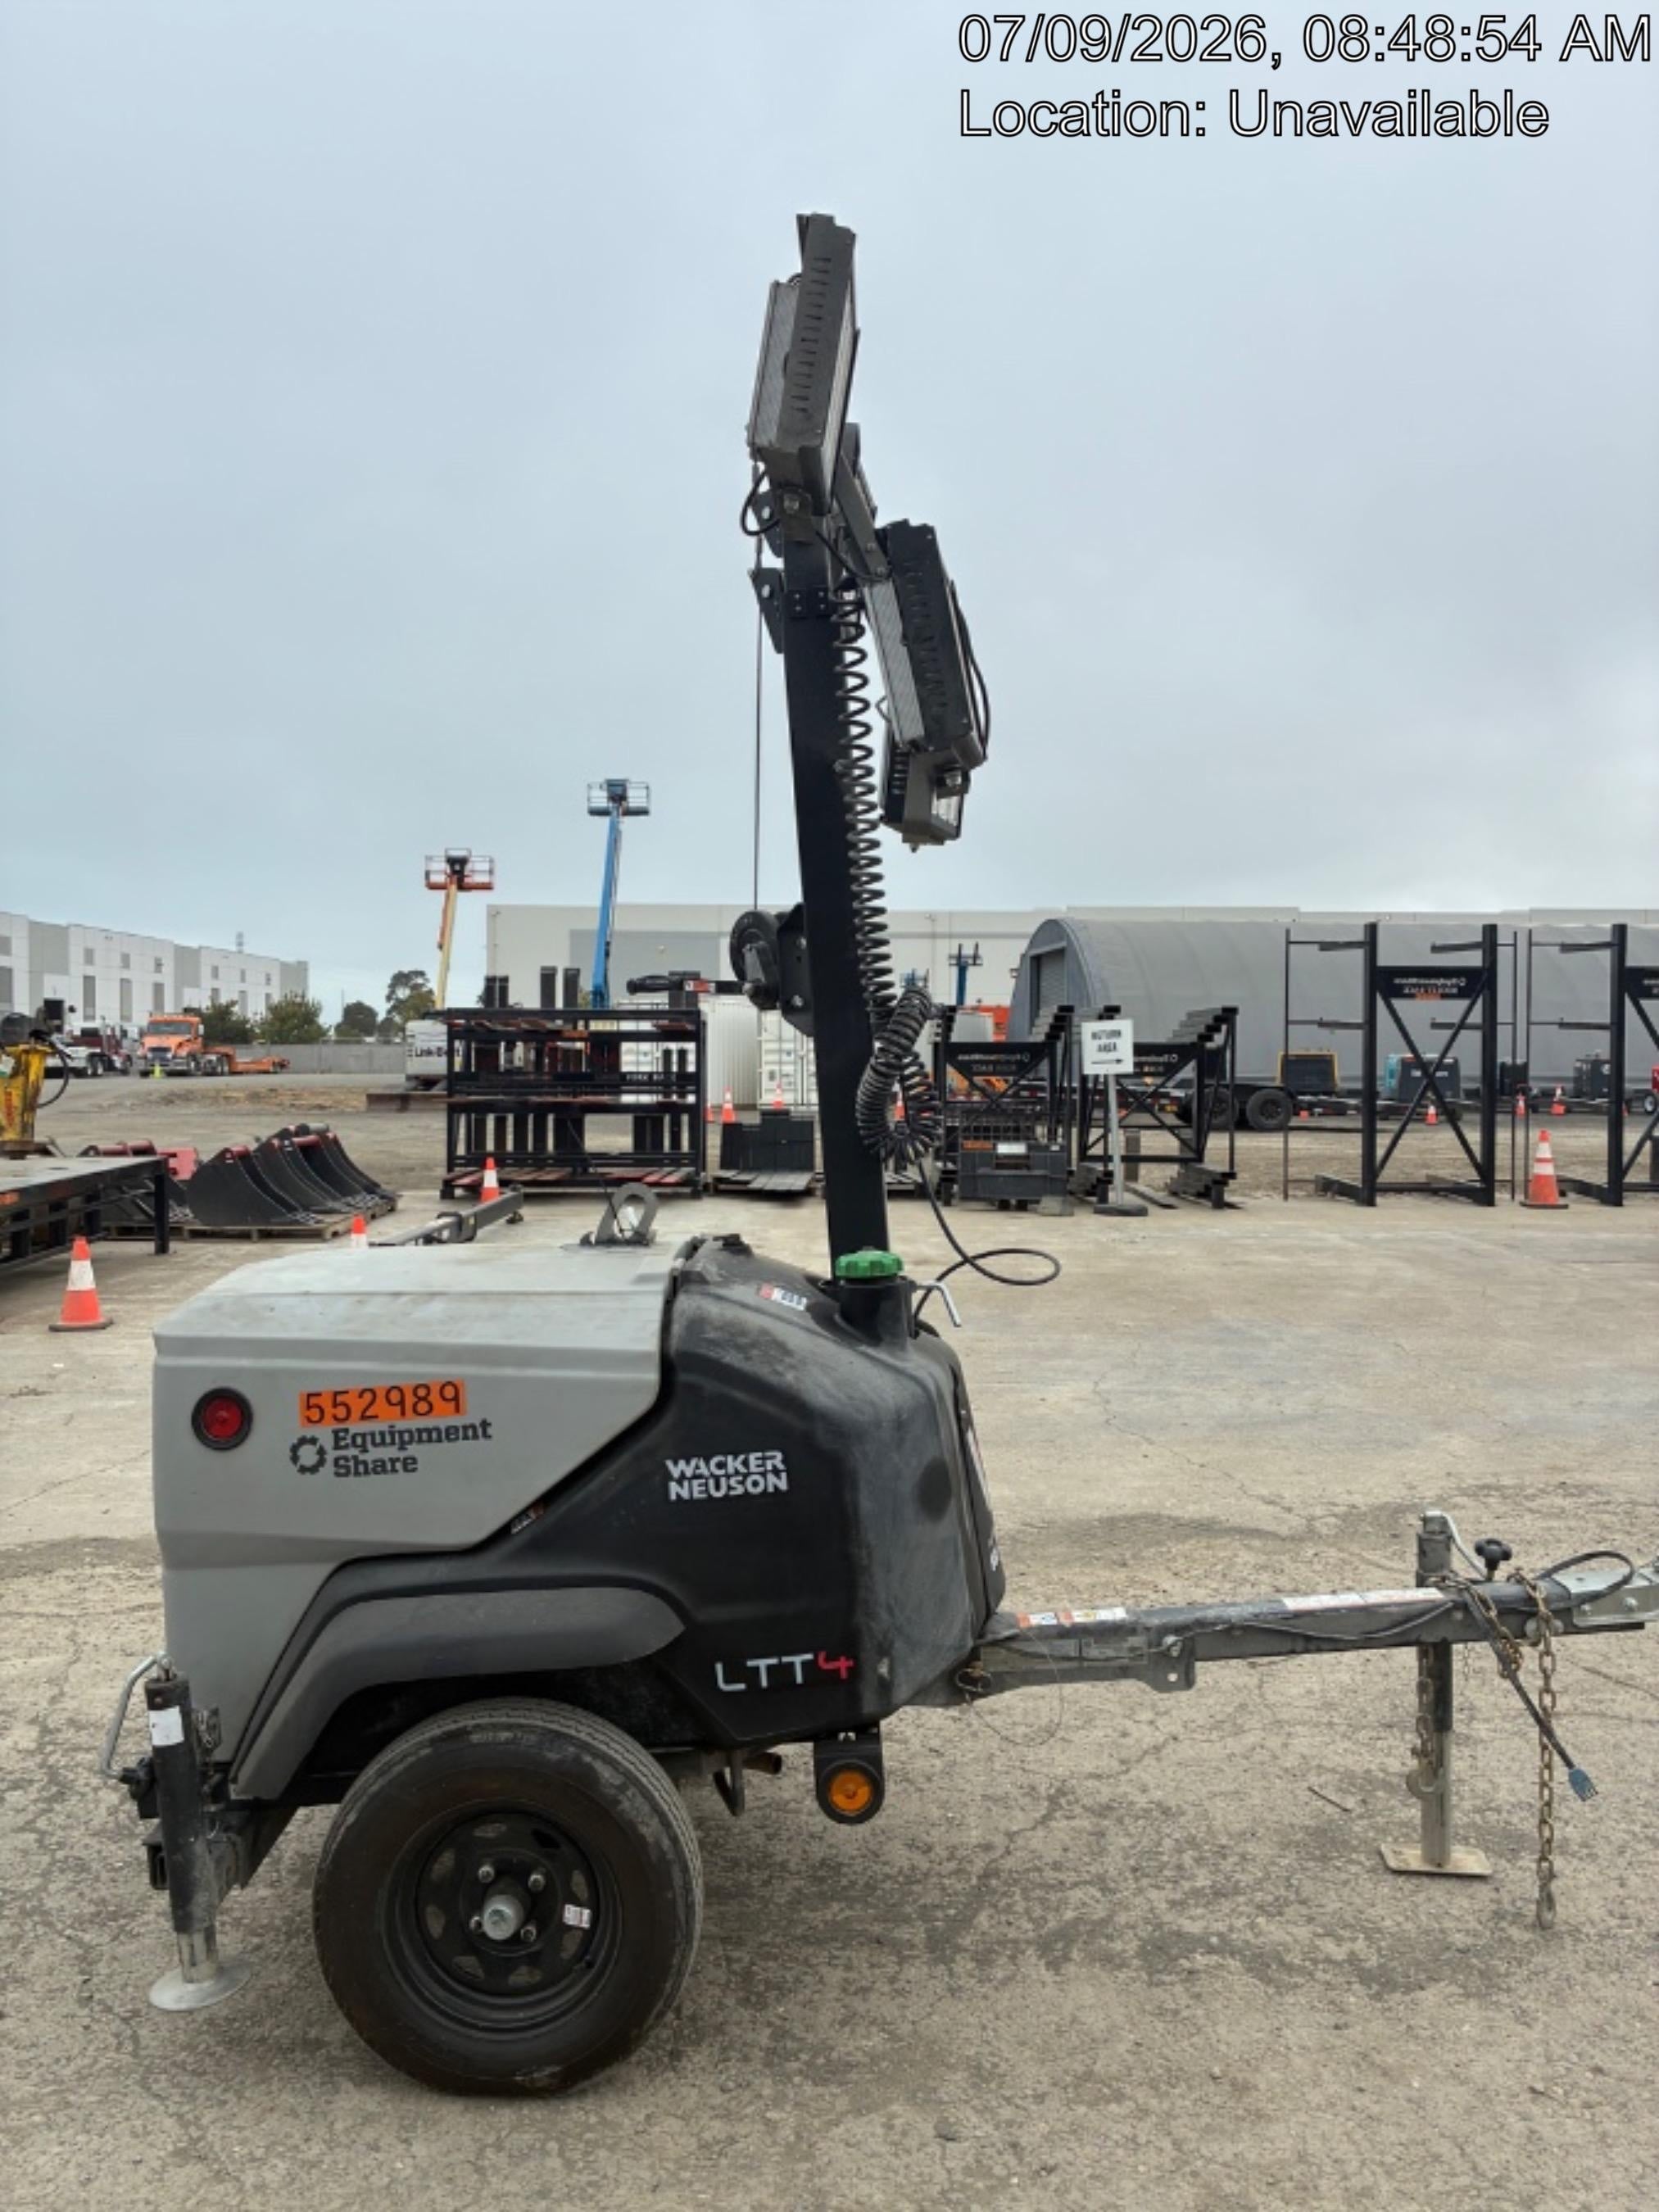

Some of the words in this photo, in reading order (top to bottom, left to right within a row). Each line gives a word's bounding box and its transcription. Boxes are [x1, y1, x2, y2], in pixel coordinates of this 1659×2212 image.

[304, 1380, 461, 1425] 552989
[331, 1418, 492, 1453] Equipment
[333, 1454, 419, 1479] Share
[666, 1450, 786, 1478] WACKER
[668, 1471, 789, 1502] NEUSON
